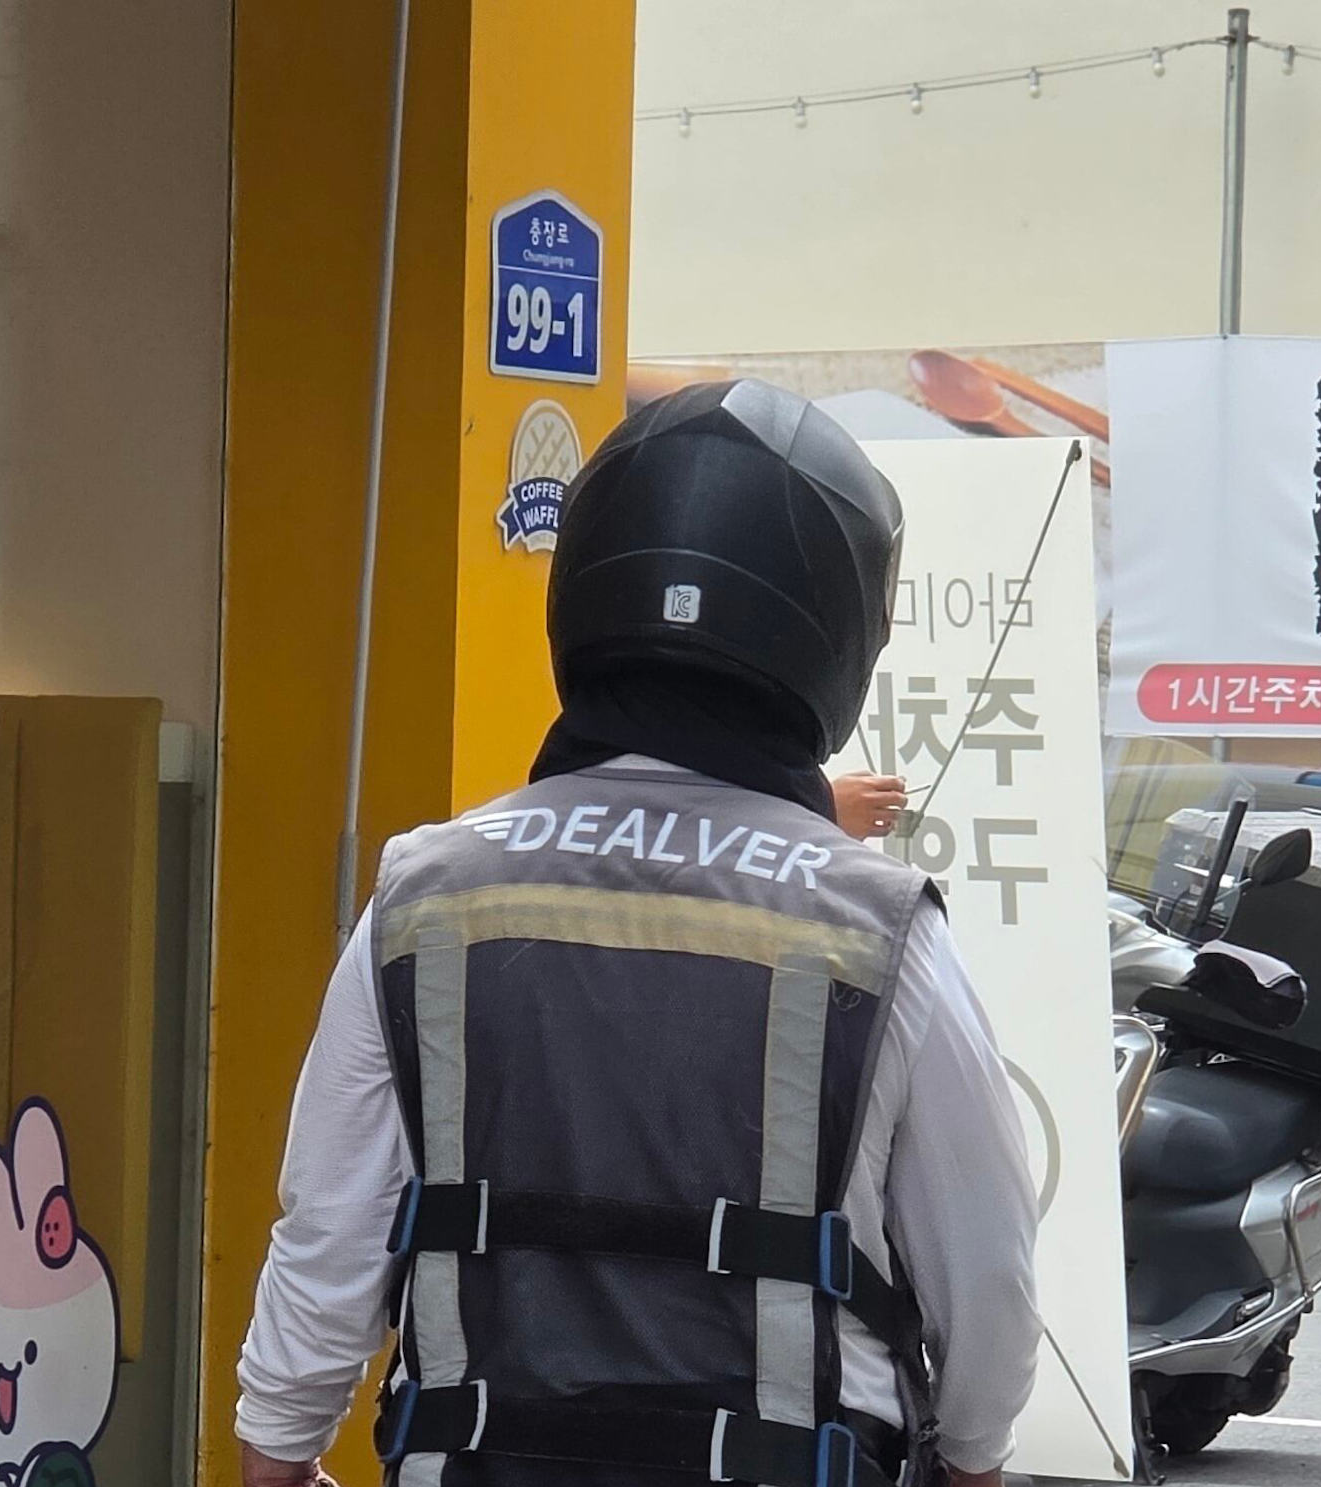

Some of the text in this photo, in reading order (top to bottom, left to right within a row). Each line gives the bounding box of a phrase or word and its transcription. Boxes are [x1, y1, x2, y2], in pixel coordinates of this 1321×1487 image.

[529, 217, 570, 248] 충장로
[507, 283, 583, 358] 99-1
[520, 481, 564, 502] COFFEE
[522, 504, 559, 529] WAFFL
[504, 805, 833, 891] DEALVER
